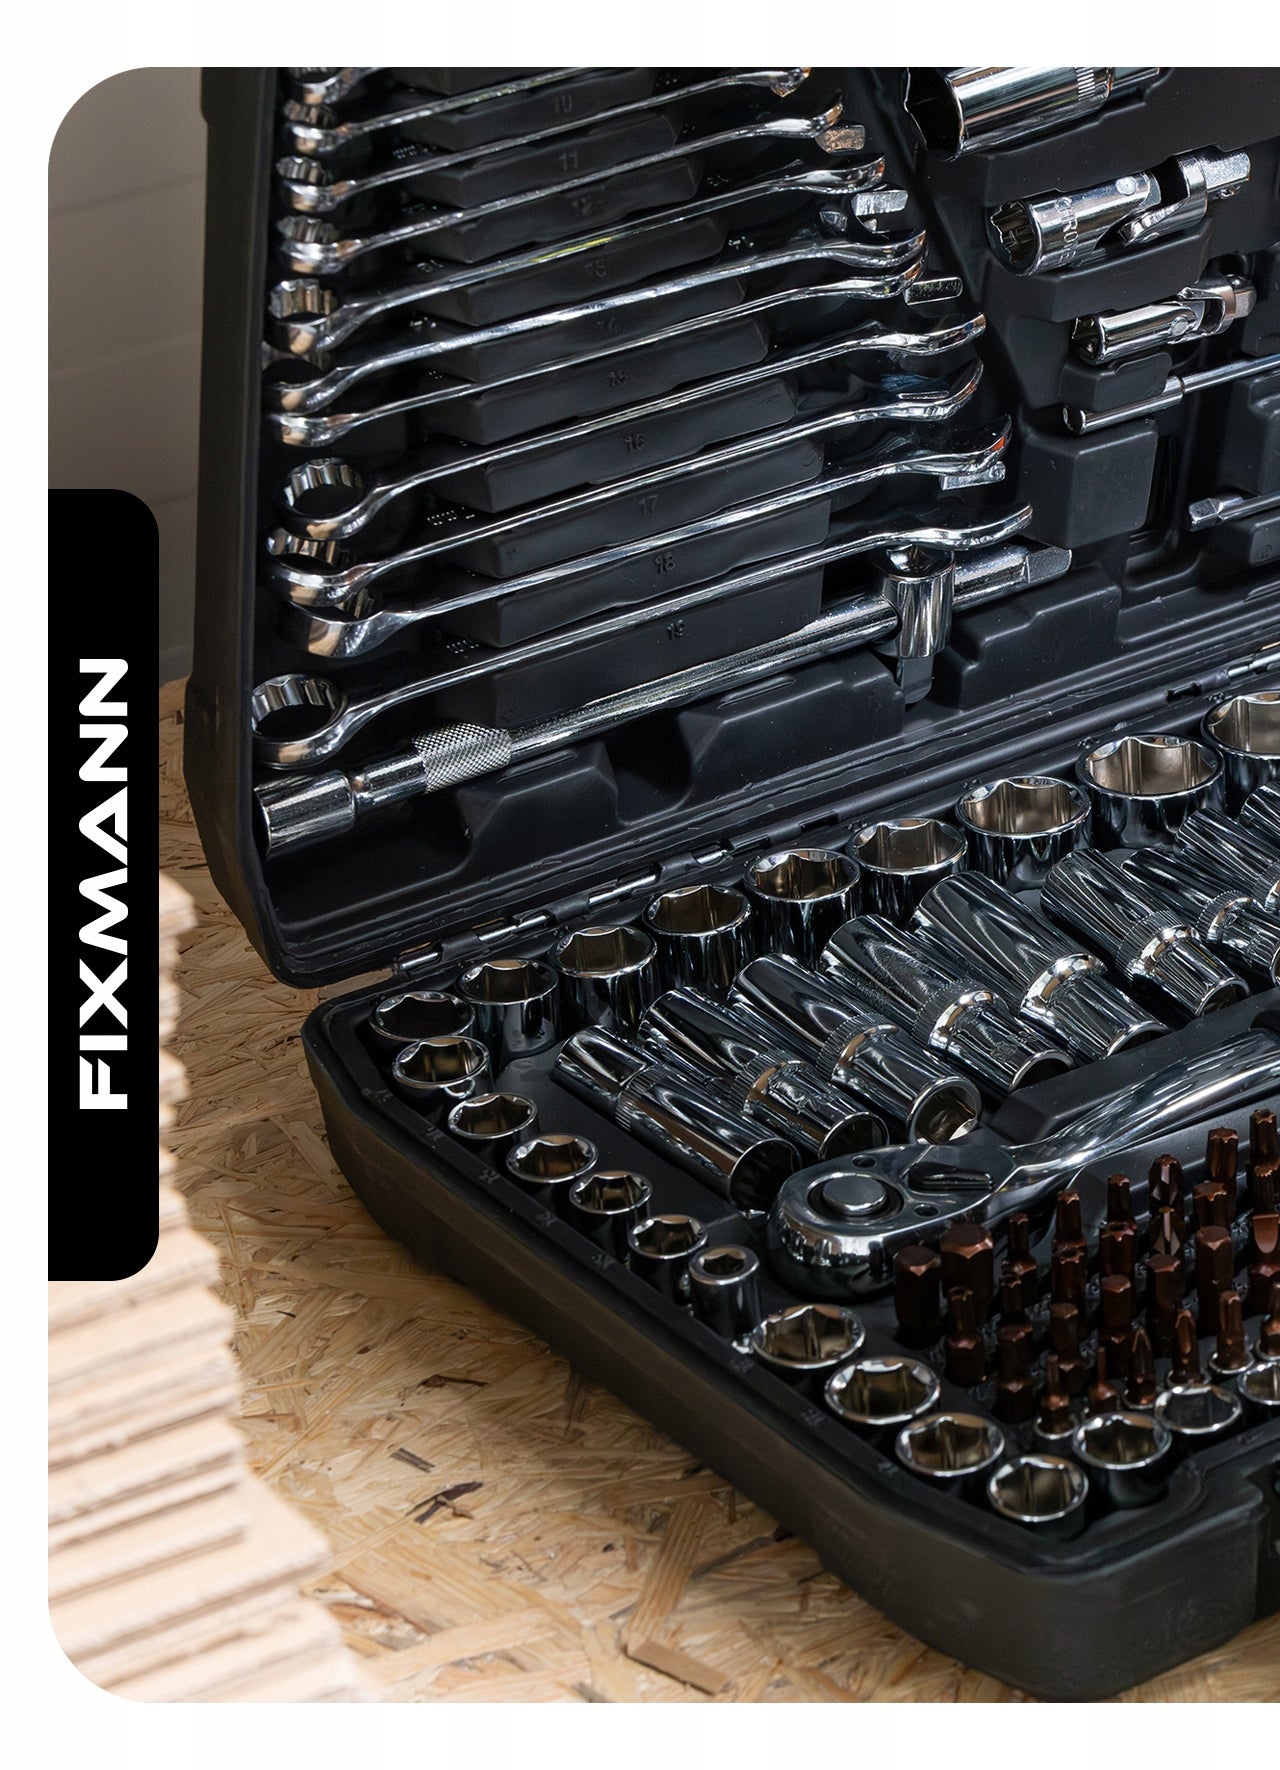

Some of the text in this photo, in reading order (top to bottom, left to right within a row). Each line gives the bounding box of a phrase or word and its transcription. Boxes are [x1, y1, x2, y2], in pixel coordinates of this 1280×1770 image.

[552, 94, 573, 114] 10
[558, 150, 579, 171] 11
[624, 434, 645, 451] 16
[638, 494, 659, 516] 17
[655, 552, 676, 575] 18
[665, 619, 685, 640] 19
